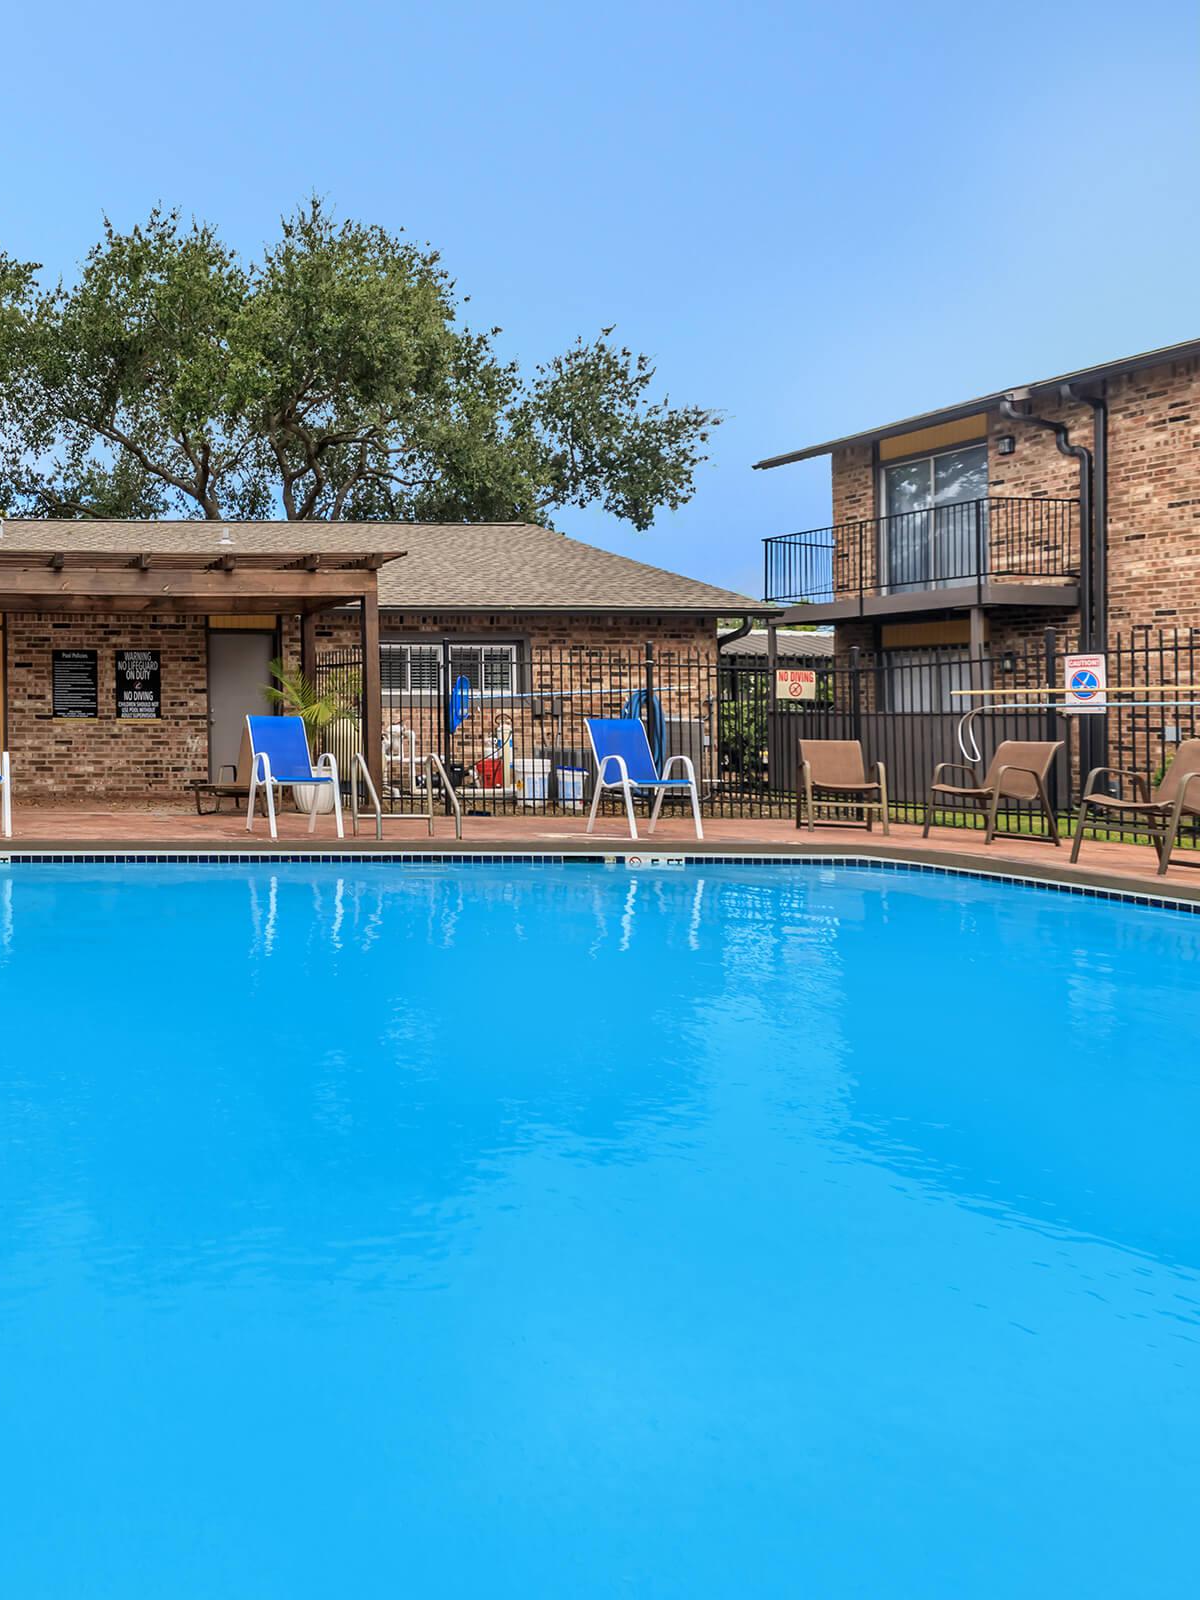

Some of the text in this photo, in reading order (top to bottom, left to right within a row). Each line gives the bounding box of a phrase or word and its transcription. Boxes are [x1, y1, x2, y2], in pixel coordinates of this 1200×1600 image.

[123, 651, 152, 661] WARNING
[118, 661, 158, 670] NO LIFEGUARD
[125, 670, 150, 680] ON DUTY
[779, 672, 814, 682] NO DIVING
[123, 691, 154, 701] NO DIVING
